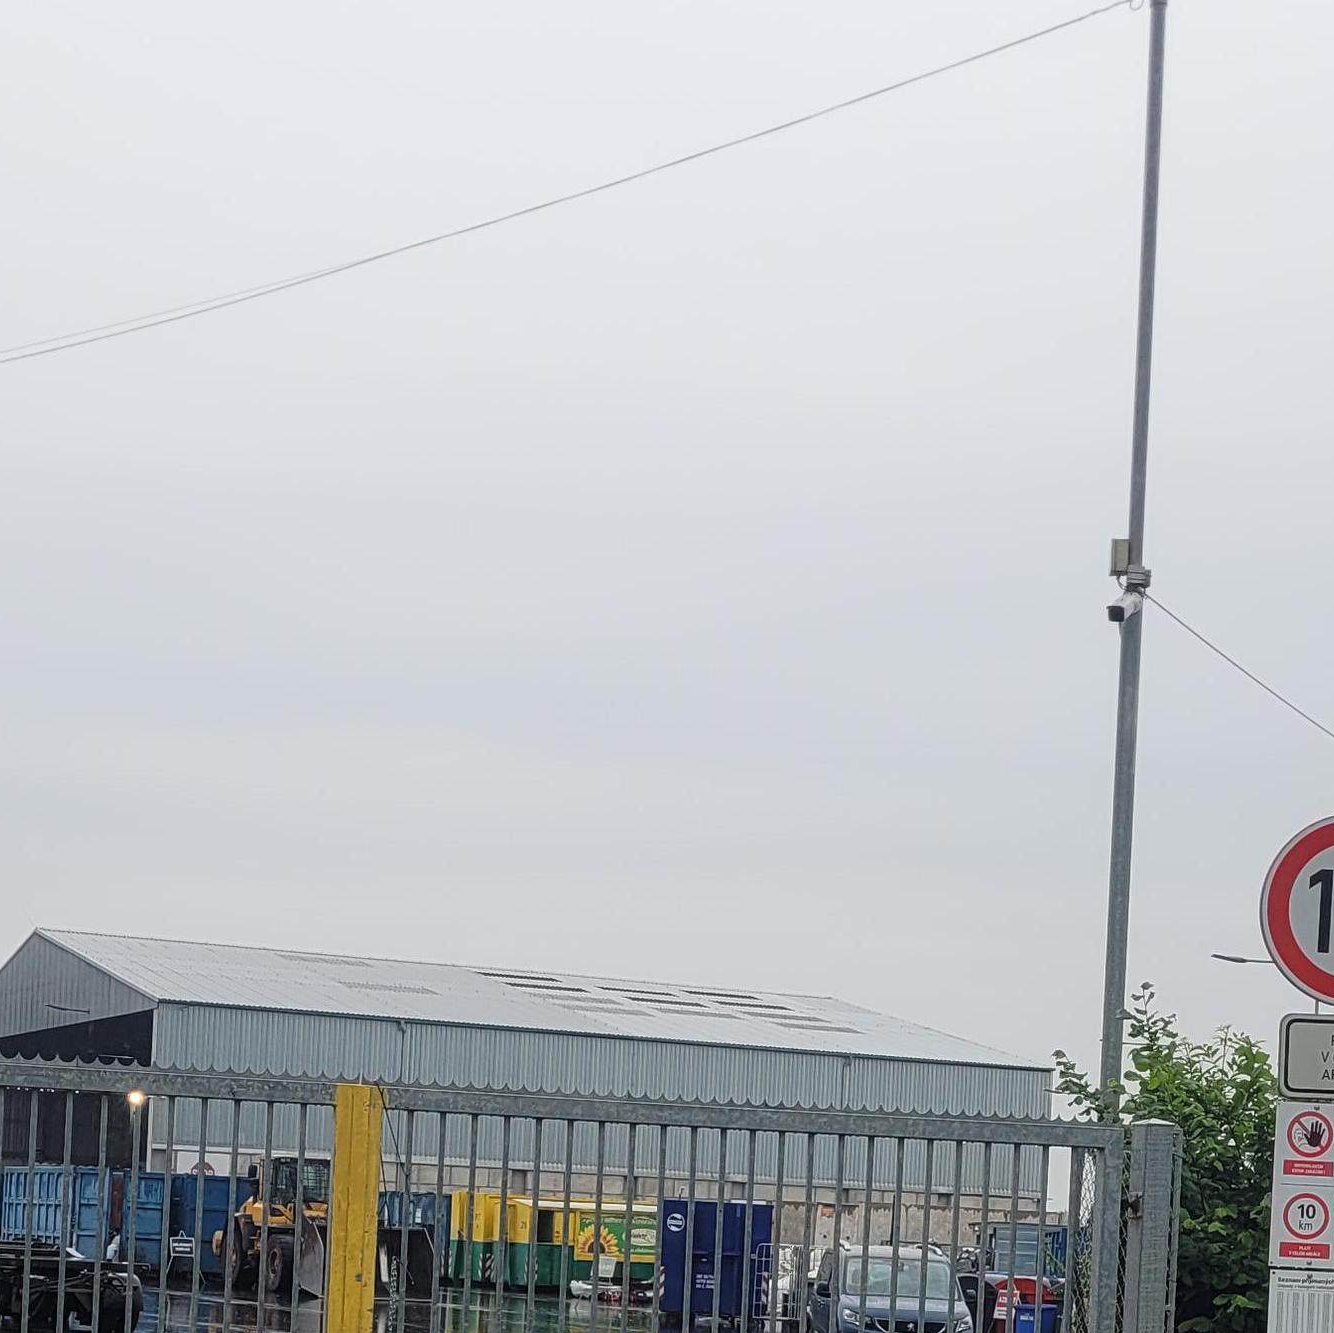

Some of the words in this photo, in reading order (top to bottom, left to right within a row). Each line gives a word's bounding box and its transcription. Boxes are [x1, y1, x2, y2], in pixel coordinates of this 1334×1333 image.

[1321, 1051, 1330, 1064] V
[1297, 1204, 1316, 1219] 10
[1298, 1220, 1313, 1231] km
